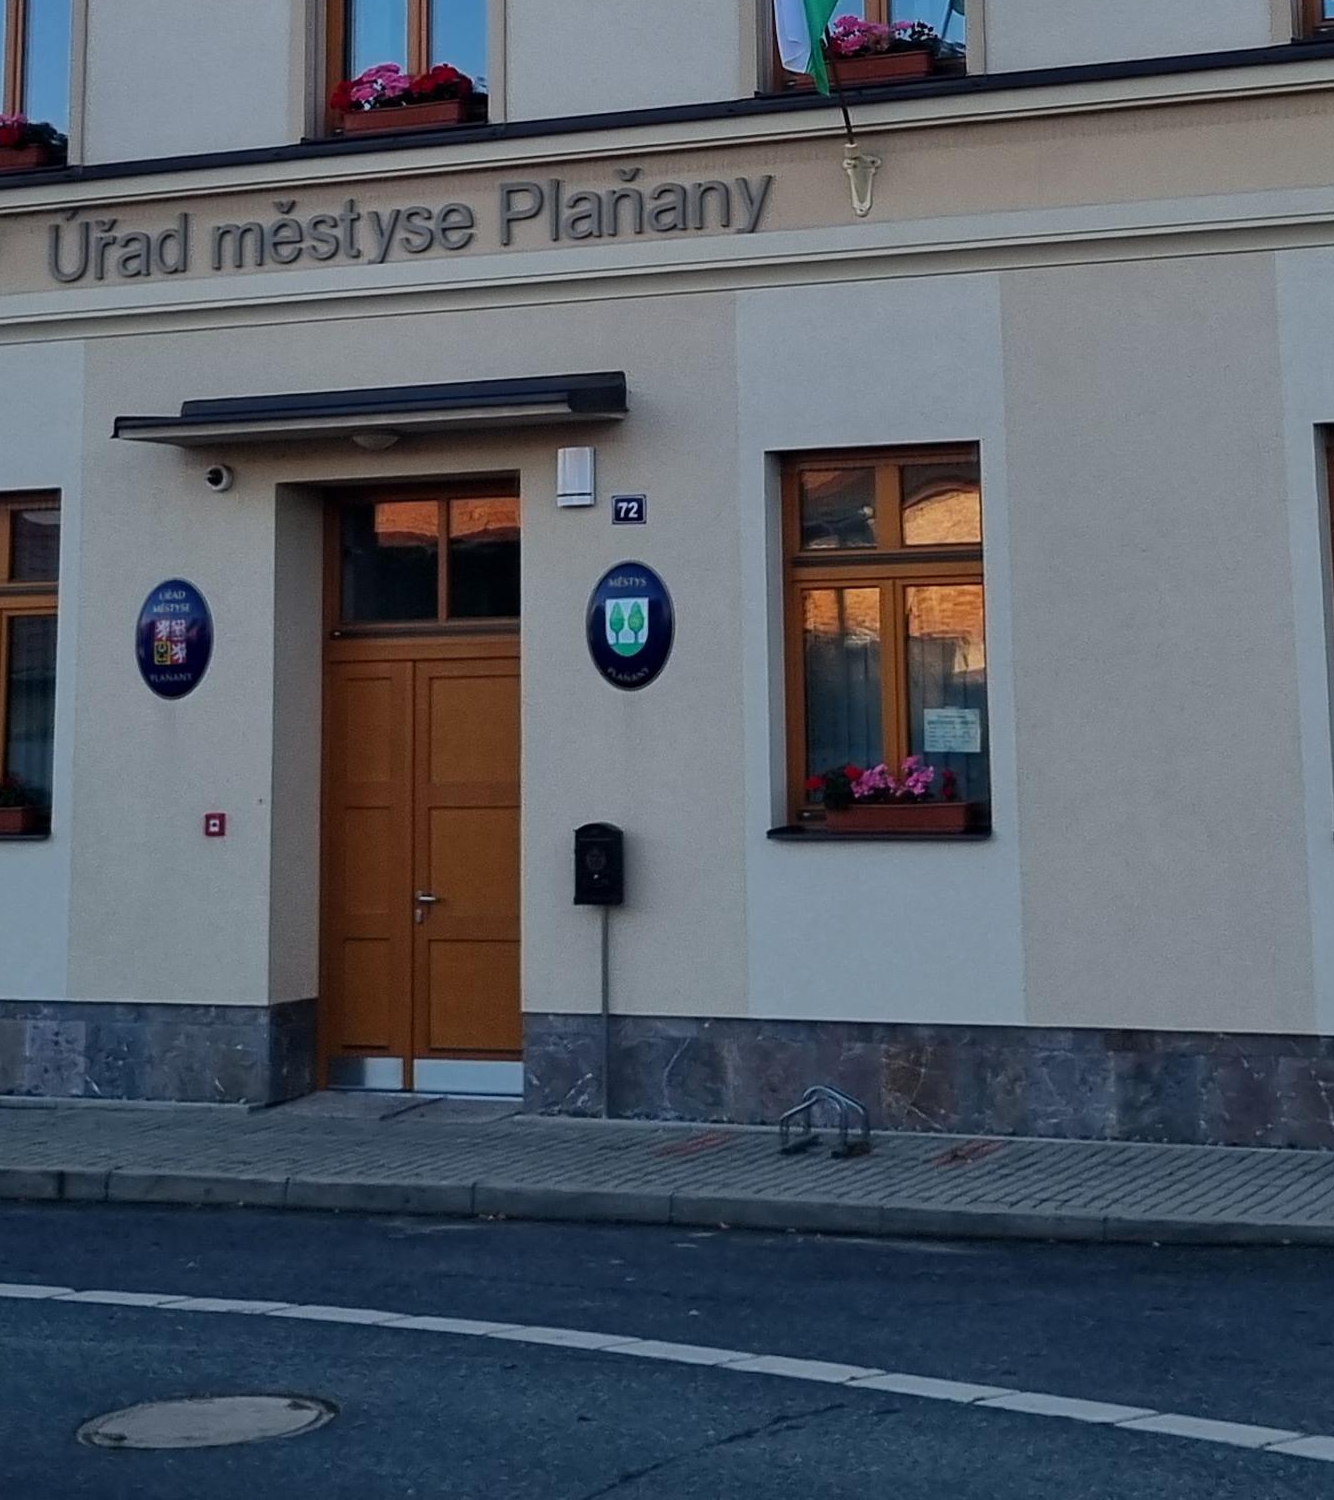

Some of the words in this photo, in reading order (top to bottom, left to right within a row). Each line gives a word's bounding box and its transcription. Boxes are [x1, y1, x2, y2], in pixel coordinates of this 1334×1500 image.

[48, 210, 189, 283] Úřad
[211, 198, 475, 266] městyse
[500, 167, 773, 246] Plaňany
[617, 501, 638, 518] 72
